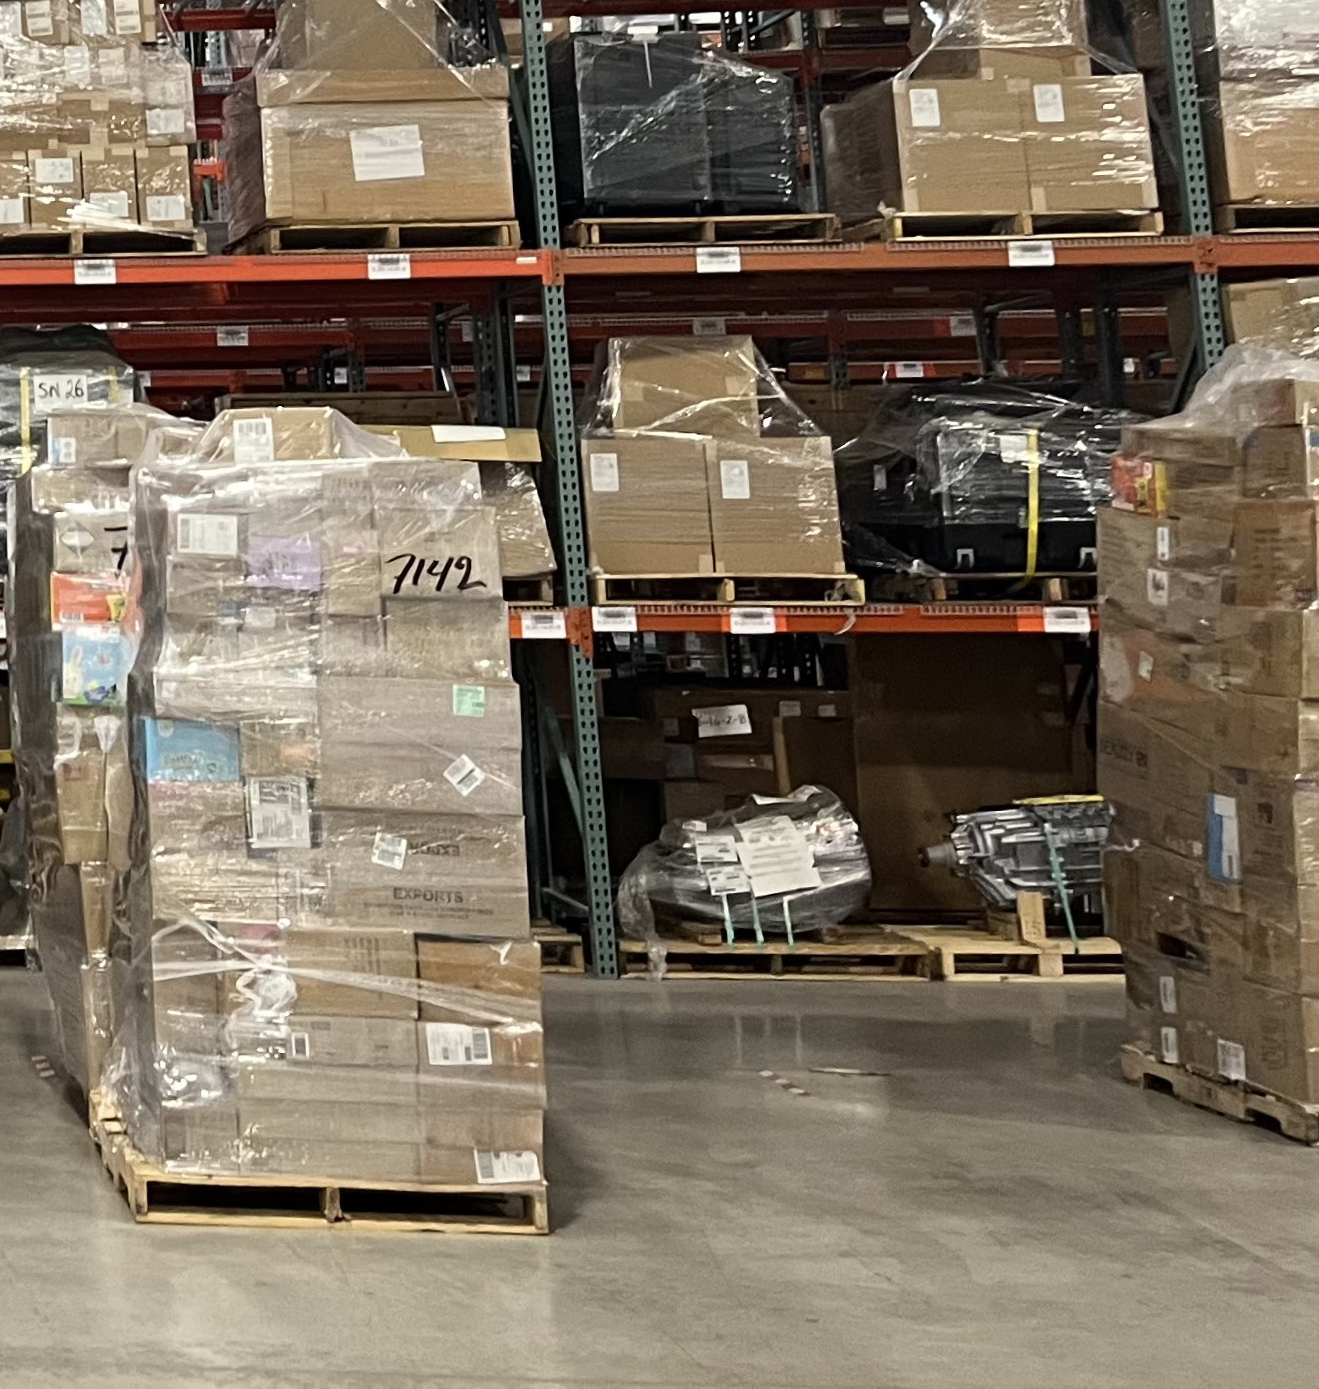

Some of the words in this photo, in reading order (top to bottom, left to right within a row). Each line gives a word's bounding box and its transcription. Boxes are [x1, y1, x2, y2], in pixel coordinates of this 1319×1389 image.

[65, 378, 86, 399] 26
[384, 552, 488, 595] 7142
[392, 886, 465, 904] EXPORTS
